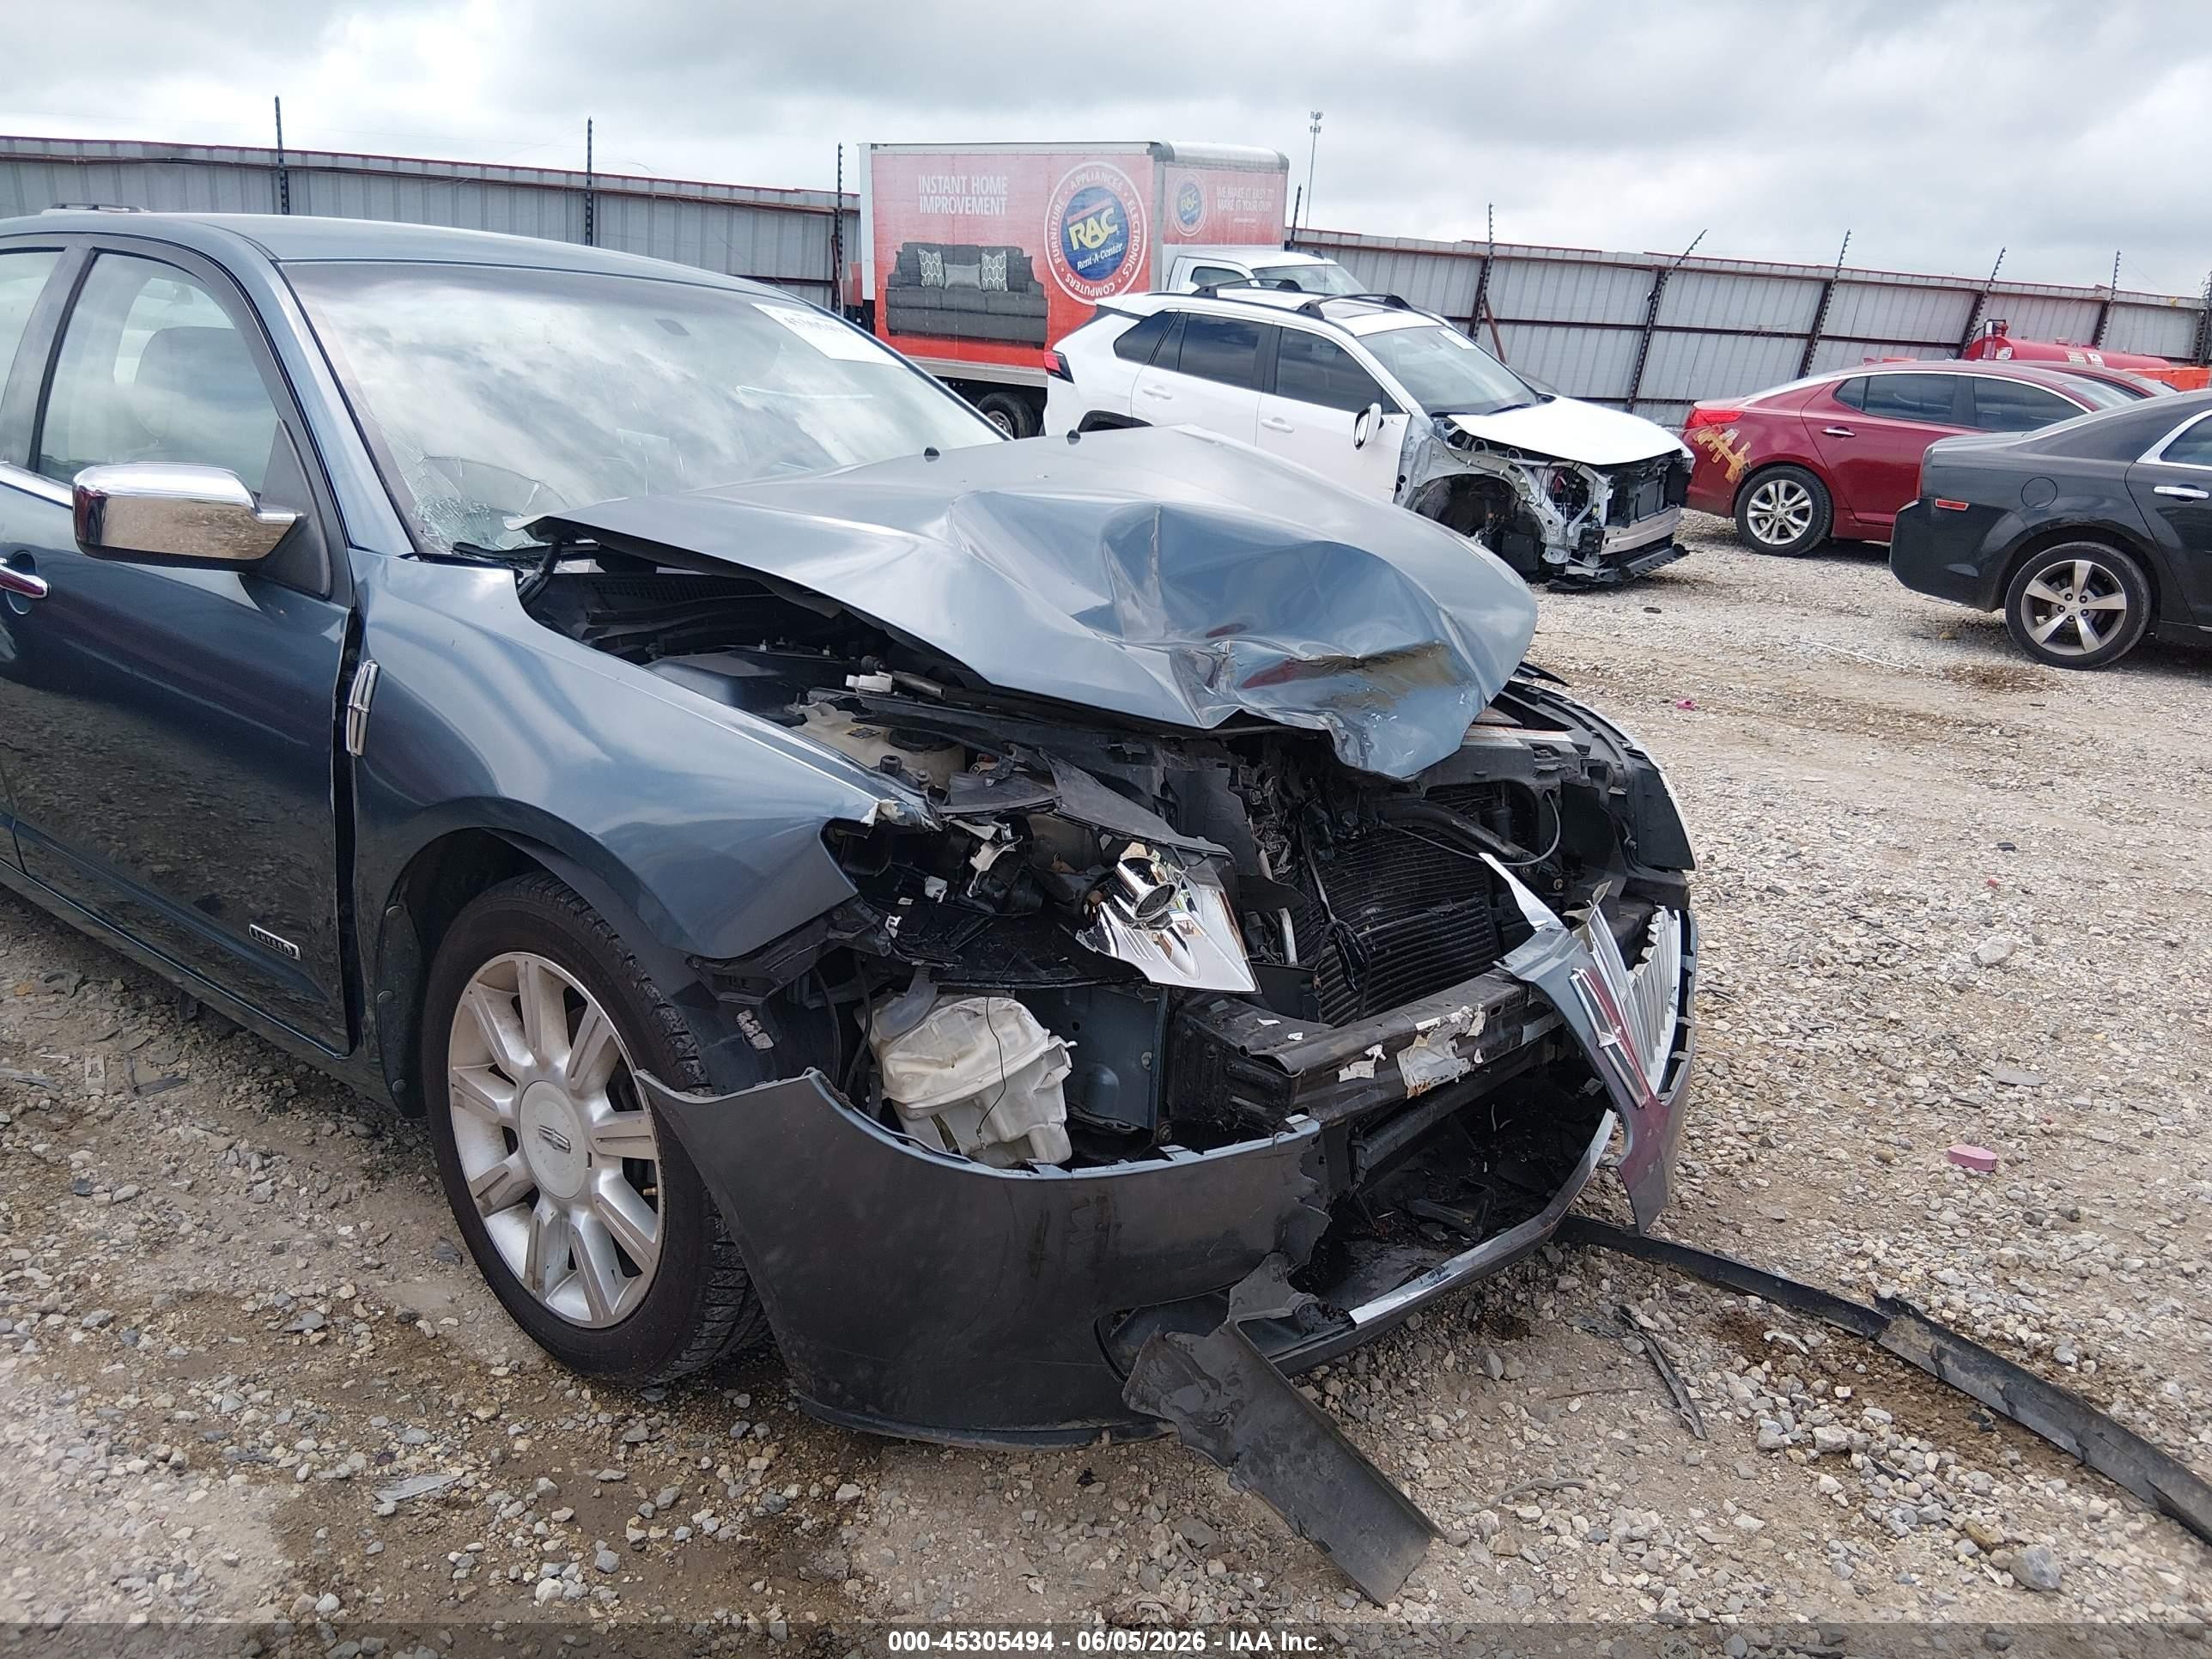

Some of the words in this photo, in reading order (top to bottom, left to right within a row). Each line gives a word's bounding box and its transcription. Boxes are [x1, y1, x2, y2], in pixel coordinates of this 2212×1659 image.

[919, 176, 967, 194] INSTANT
[971, 176, 1008, 195] HOME
[1070, 171, 1123, 192] APPLIANCES
[920, 196, 1007, 215] IMPROVEMENT
[1051, 197, 1066, 264] FURNITURE
[1069, 207, 1118, 251] RAC
[1122, 199, 1140, 276] ELECTRONICS
[1065, 273, 1115, 297] COMPUTERS
